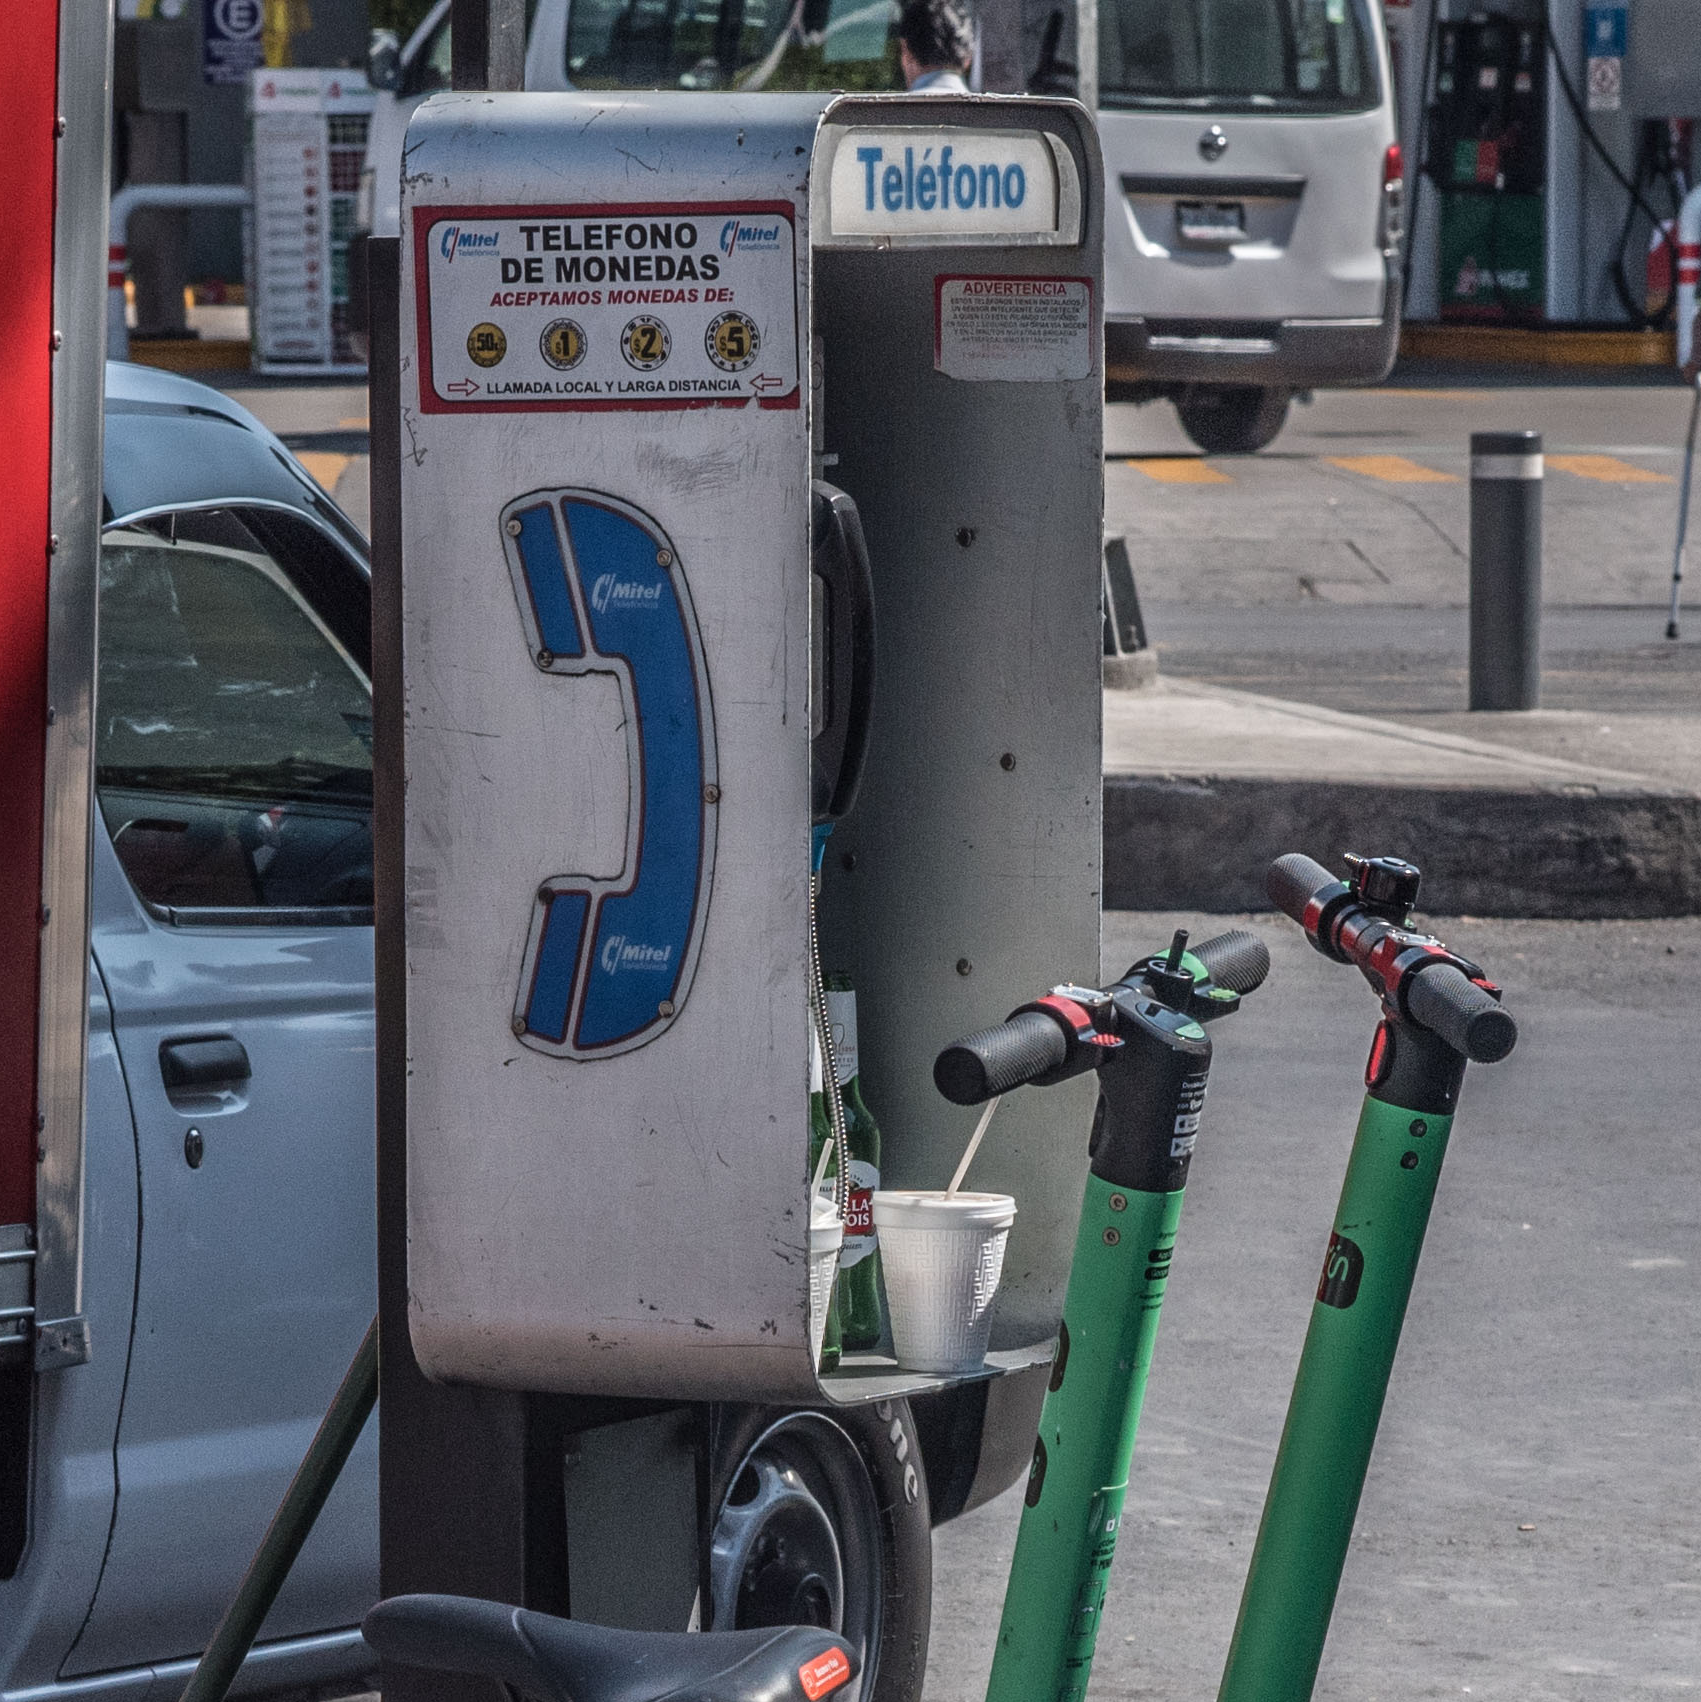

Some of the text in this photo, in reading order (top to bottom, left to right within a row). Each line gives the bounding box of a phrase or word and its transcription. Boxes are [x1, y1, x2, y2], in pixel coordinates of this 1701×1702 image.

[856, 145, 1027, 214] Teléfono
[458, 231, 500, 247] Mitel
[519, 223, 697, 251] TELEFONO
[737, 225, 780, 242] Mitel
[501, 253, 720, 284] DE MONEDAS
[490, 287, 735, 307] ACEPTAMOS MONEDAS DE:
[963, 281, 1067, 296] ADVERTENCIA
[487, 379, 741, 394] LLAMADA LOCAL Y LARGA DISTANCIA
[612, 582, 662, 600] Mitel
[621, 943, 672, 962] Mitel
[846, 1213, 870, 1226] OIS
